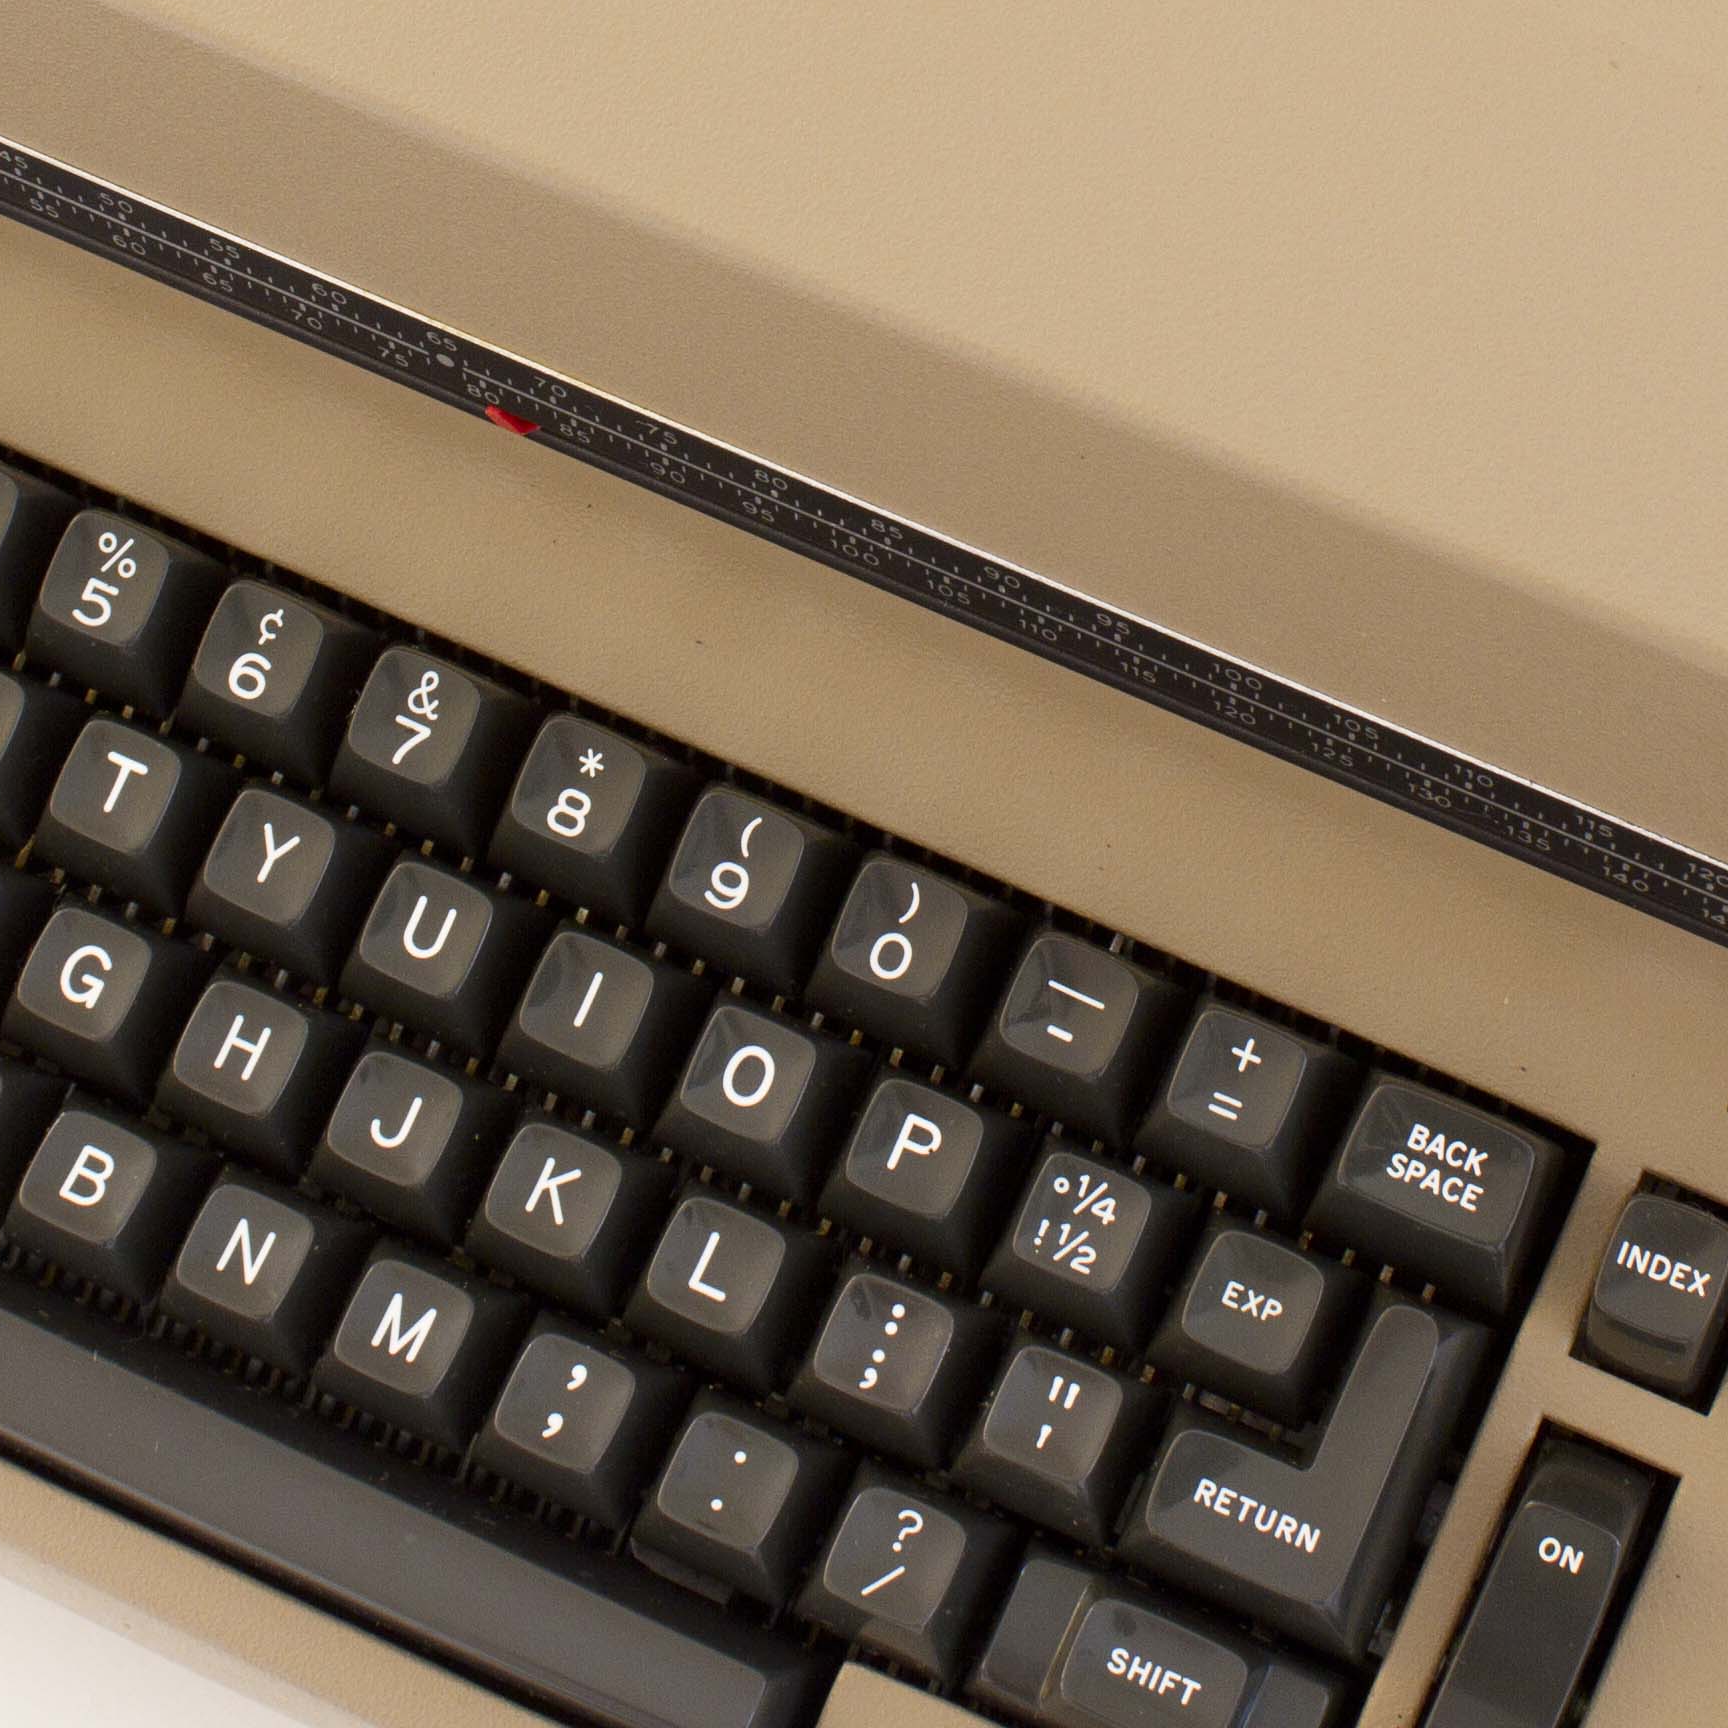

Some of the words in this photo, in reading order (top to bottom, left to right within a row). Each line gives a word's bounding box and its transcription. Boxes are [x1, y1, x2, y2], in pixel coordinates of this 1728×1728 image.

[100, 193, 133, 214] 50
[209, 238, 240, 260] 55
[311, 282, 348, 305] 60
[426, 331, 457, 352] 65
[534, 377, 567, 398] 70
[646, 422, 678, 445] 75
[754, 469, 788, 491] 80
[871, 519, 903, 540] 85
[984, 566, 1021, 589] 90
[1096, 612, 1131, 636] 95
[1213, 661, 1262, 691] 100
[1334, 713, 1379, 740] 105
[1453, 763, 1494, 788] 110
[1574, 814, 1613, 839] 115
[29, 198, 60, 219] 55
[113, 234, 147, 256] 60
[202, 272, 234, 293] 65
[290, 309, 323, 331] 70
[377, 346, 409, 368] 75
[467, 383, 500, 405] 80
[559, 423, 590, 444] 85
[650, 461, 686, 485] 90
[742, 500, 774, 523] 95
[831, 539, 880, 566] 100
[927, 578, 971, 605] 105
[1018, 619, 1057, 642] 110
[1119, 660, 1156, 684] 115
[1214, 699, 1257, 726] 120
[1311, 741, 1353, 768] 125
[1408, 782, 1452, 809] 130
[1506, 825, 1551, 852] 135
[1602, 866, 1649, 893] 140
[98, 532, 137, 579] %
[72, 577, 120, 627] 5
[258, 608, 284, 645] ¢
[228, 652, 272, 700] 6
[407, 670, 440, 721] &
[391, 714, 432, 765] 7
[103, 751, 149, 813] T
[546, 788, 592, 837] 8
[256, 823, 301, 883] Y
[704, 861, 750, 910] 9
[403, 895, 457, 959] U
[60, 945, 113, 1009] G
[573, 971, 604, 1027] I
[213, 1014, 272, 1081] H
[722, 1045, 775, 1107] O
[370, 1097, 423, 1148] J
[886, 1113, 942, 1170] P
[1406, 1122, 1489, 1176] BACK
[59, 1144, 115, 1206] B
[525, 1157, 582, 1225] K
[1386, 1153, 1484, 1212] SPACE
[216, 1218, 277, 1285] N
[688, 1231, 726, 1302] L
[1616, 1241, 1711, 1297] INDEX
[371, 1293, 437, 1363] M
[1221, 1280, 1283, 1321] EXP
[1193, 1478, 1321, 1553] RETURN
[1538, 1537, 1584, 1574] ON
[1106, 1647, 1202, 1705] SHIFT
